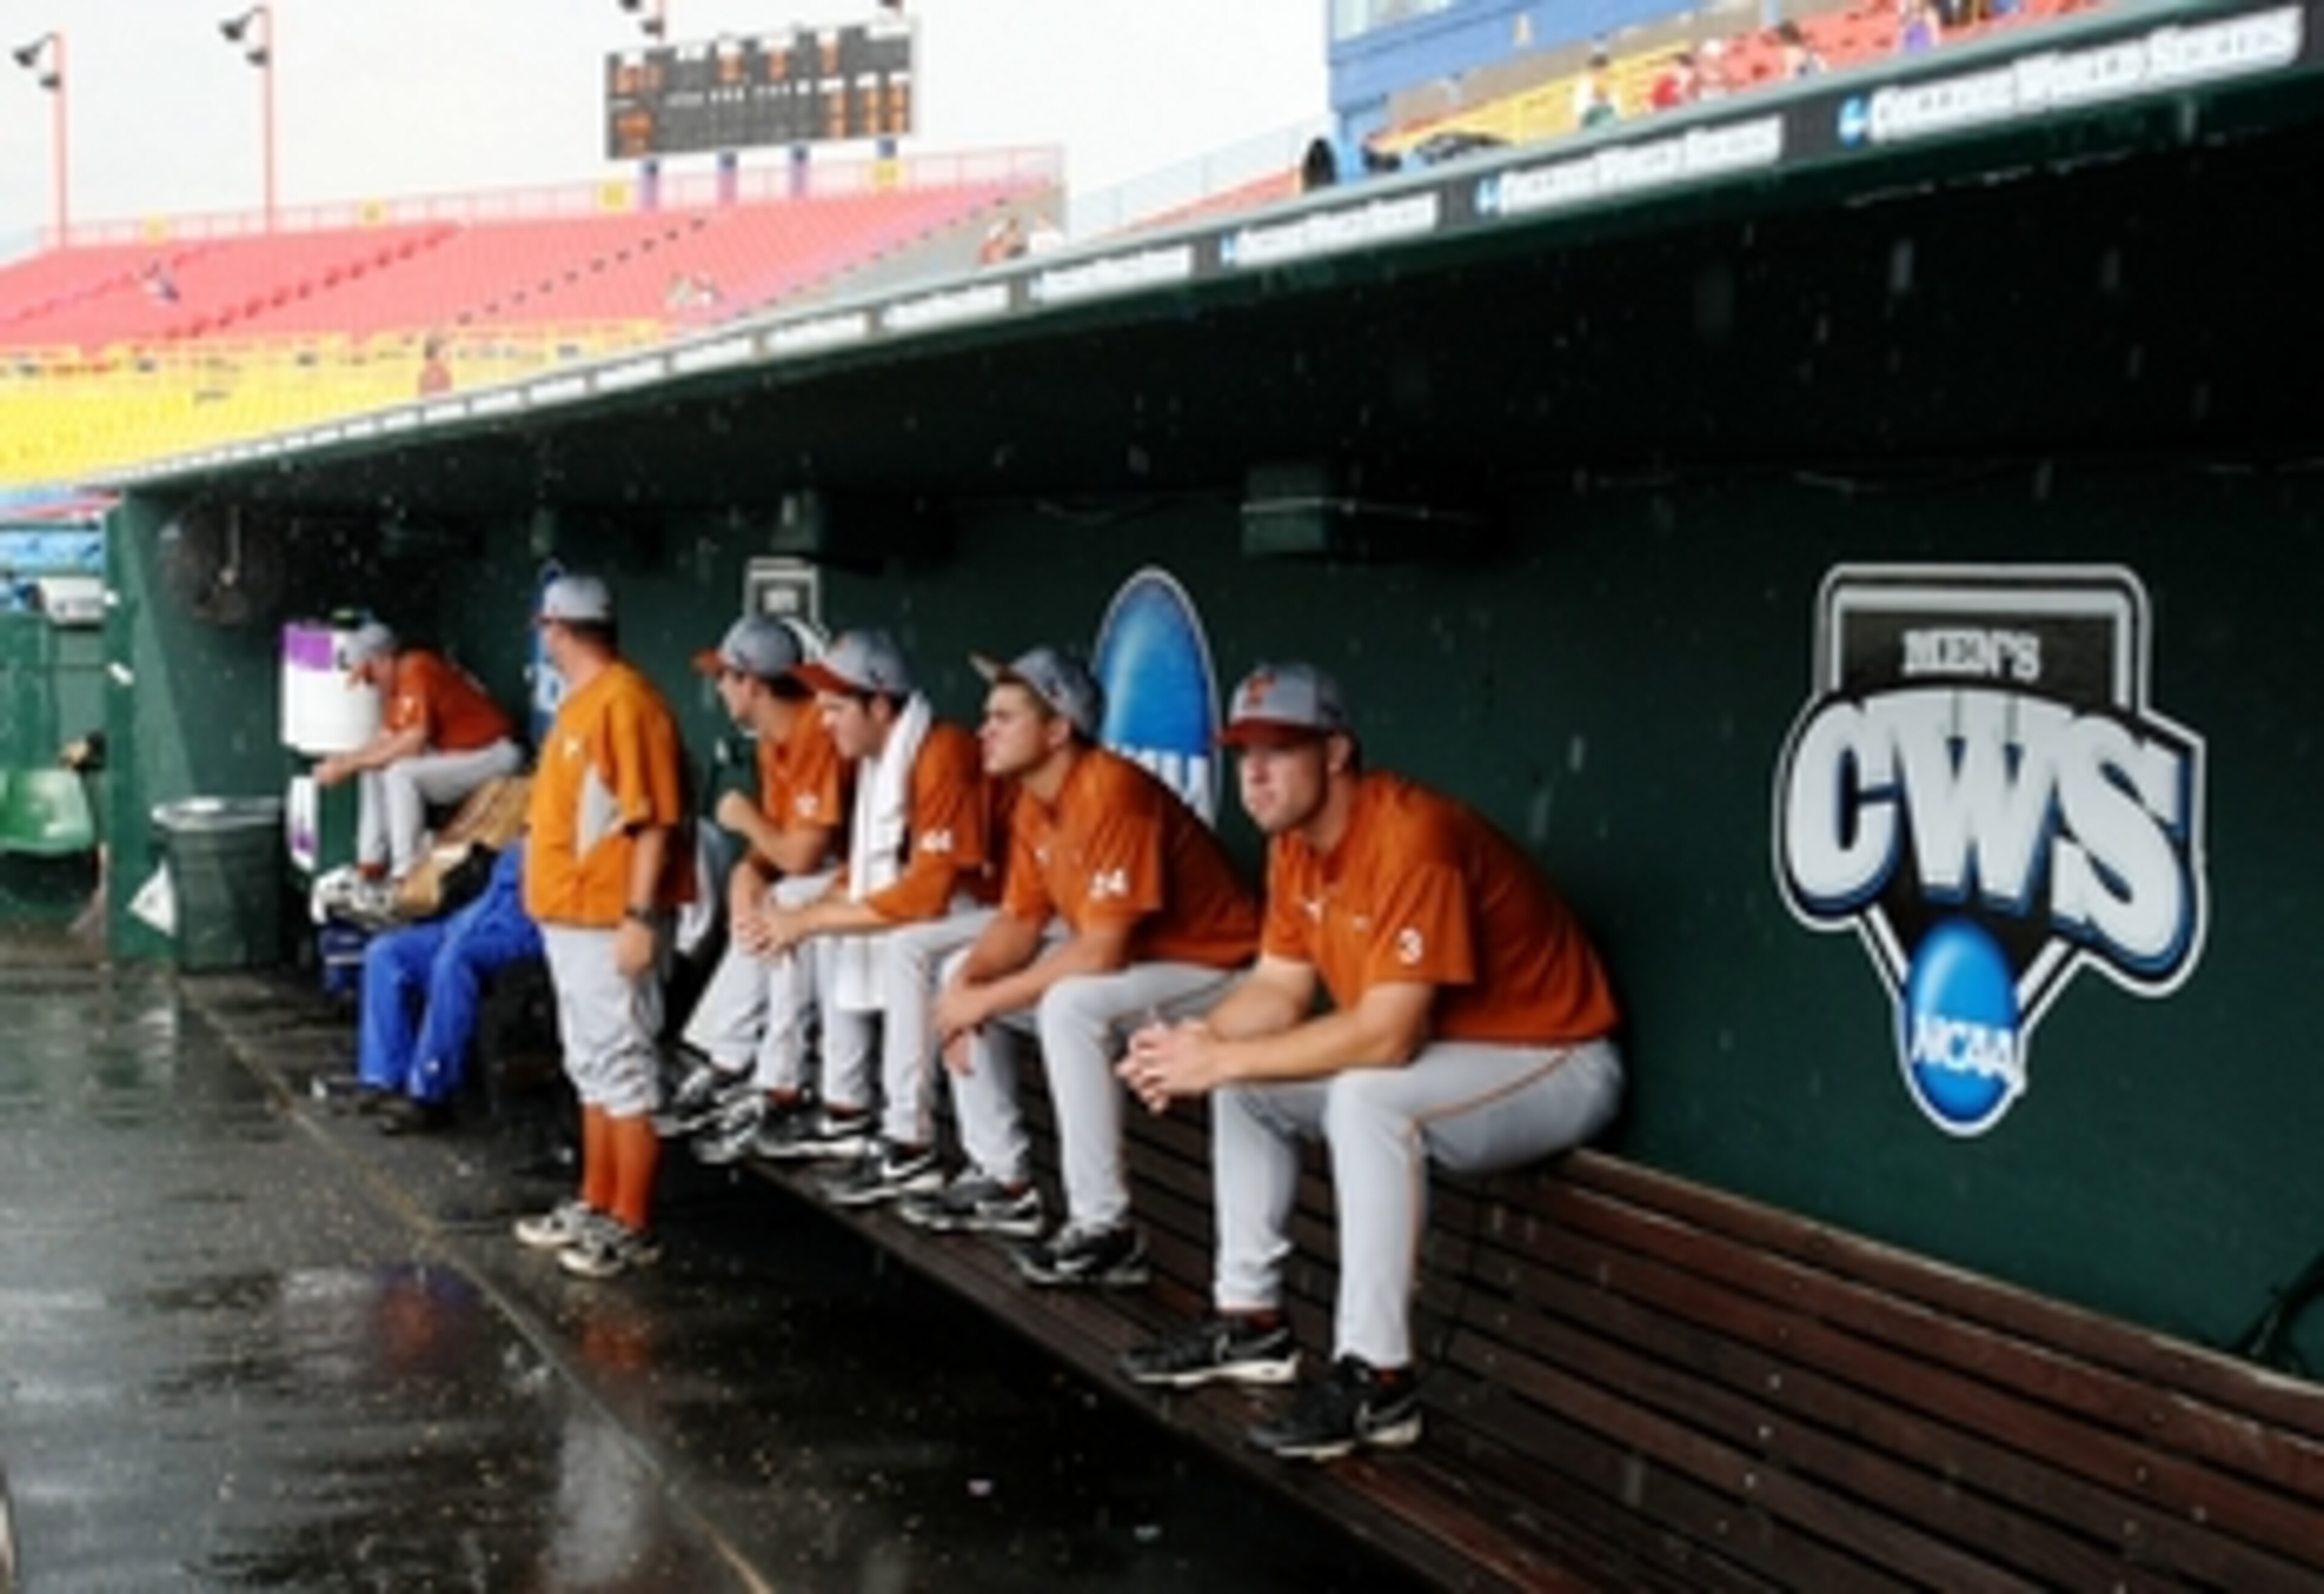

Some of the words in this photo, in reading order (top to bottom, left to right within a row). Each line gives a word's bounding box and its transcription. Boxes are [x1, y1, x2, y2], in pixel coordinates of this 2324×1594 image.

[1903, 628, 2040, 683] MEN'S
[1787, 688, 2182, 963] CWS
[1399, 927, 1422, 964] 3
[1909, 1015, 2026, 1095] NCAA
